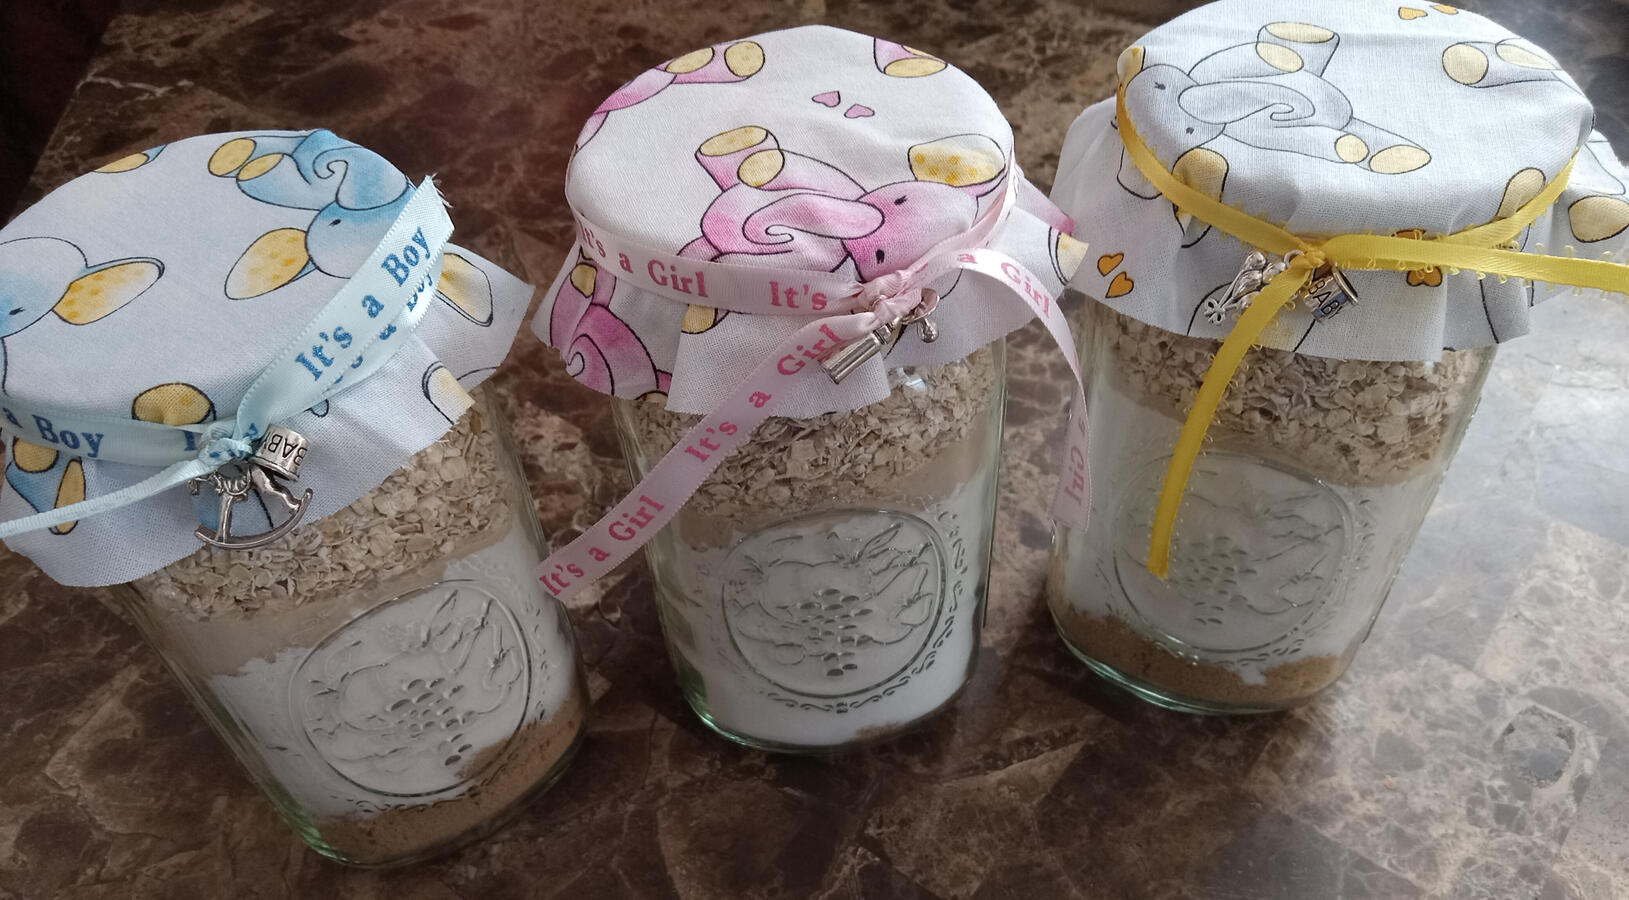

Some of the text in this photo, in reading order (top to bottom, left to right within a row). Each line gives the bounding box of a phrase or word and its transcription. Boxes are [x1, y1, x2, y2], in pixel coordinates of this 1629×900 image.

[295, 326, 353, 381] It's
[362, 295, 385, 318] a
[381, 226, 432, 287] Boy
[619, 252, 633, 273] a
[647, 259, 709, 298] Girl
[769, 281, 827, 311] It's
[957, 252, 1051, 317] a Girl
[31, 414, 104, 459] Boy
[540, 323, 842, 596] It's a Girl It's a Girl
